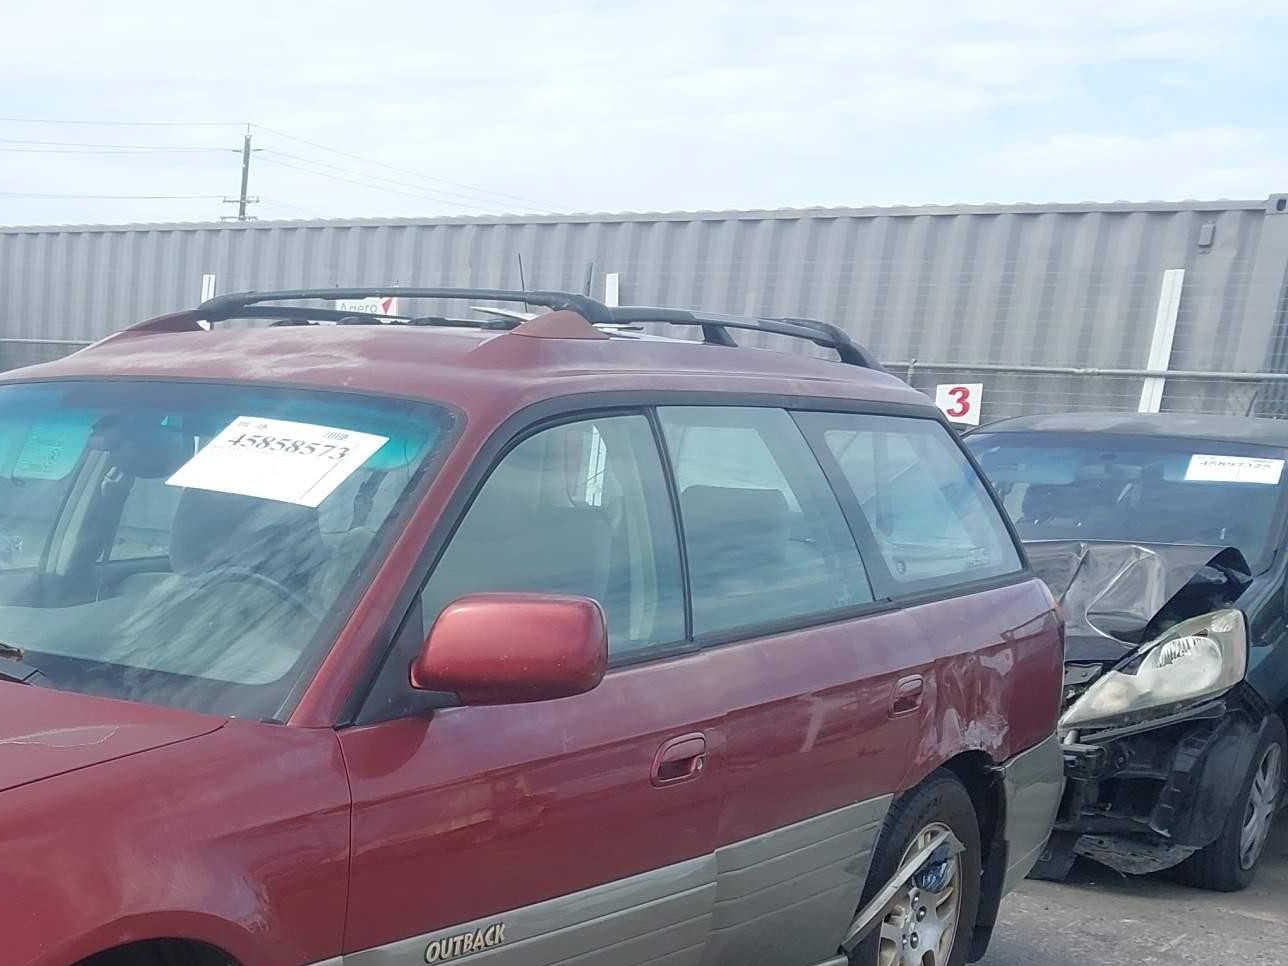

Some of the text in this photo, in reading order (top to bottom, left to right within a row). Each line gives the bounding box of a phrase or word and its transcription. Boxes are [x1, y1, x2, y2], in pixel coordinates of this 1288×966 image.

[946, 386, 970, 417] 3
[227, 433, 350, 460] 45858573
[425, 922, 506, 963] OUTBACK
